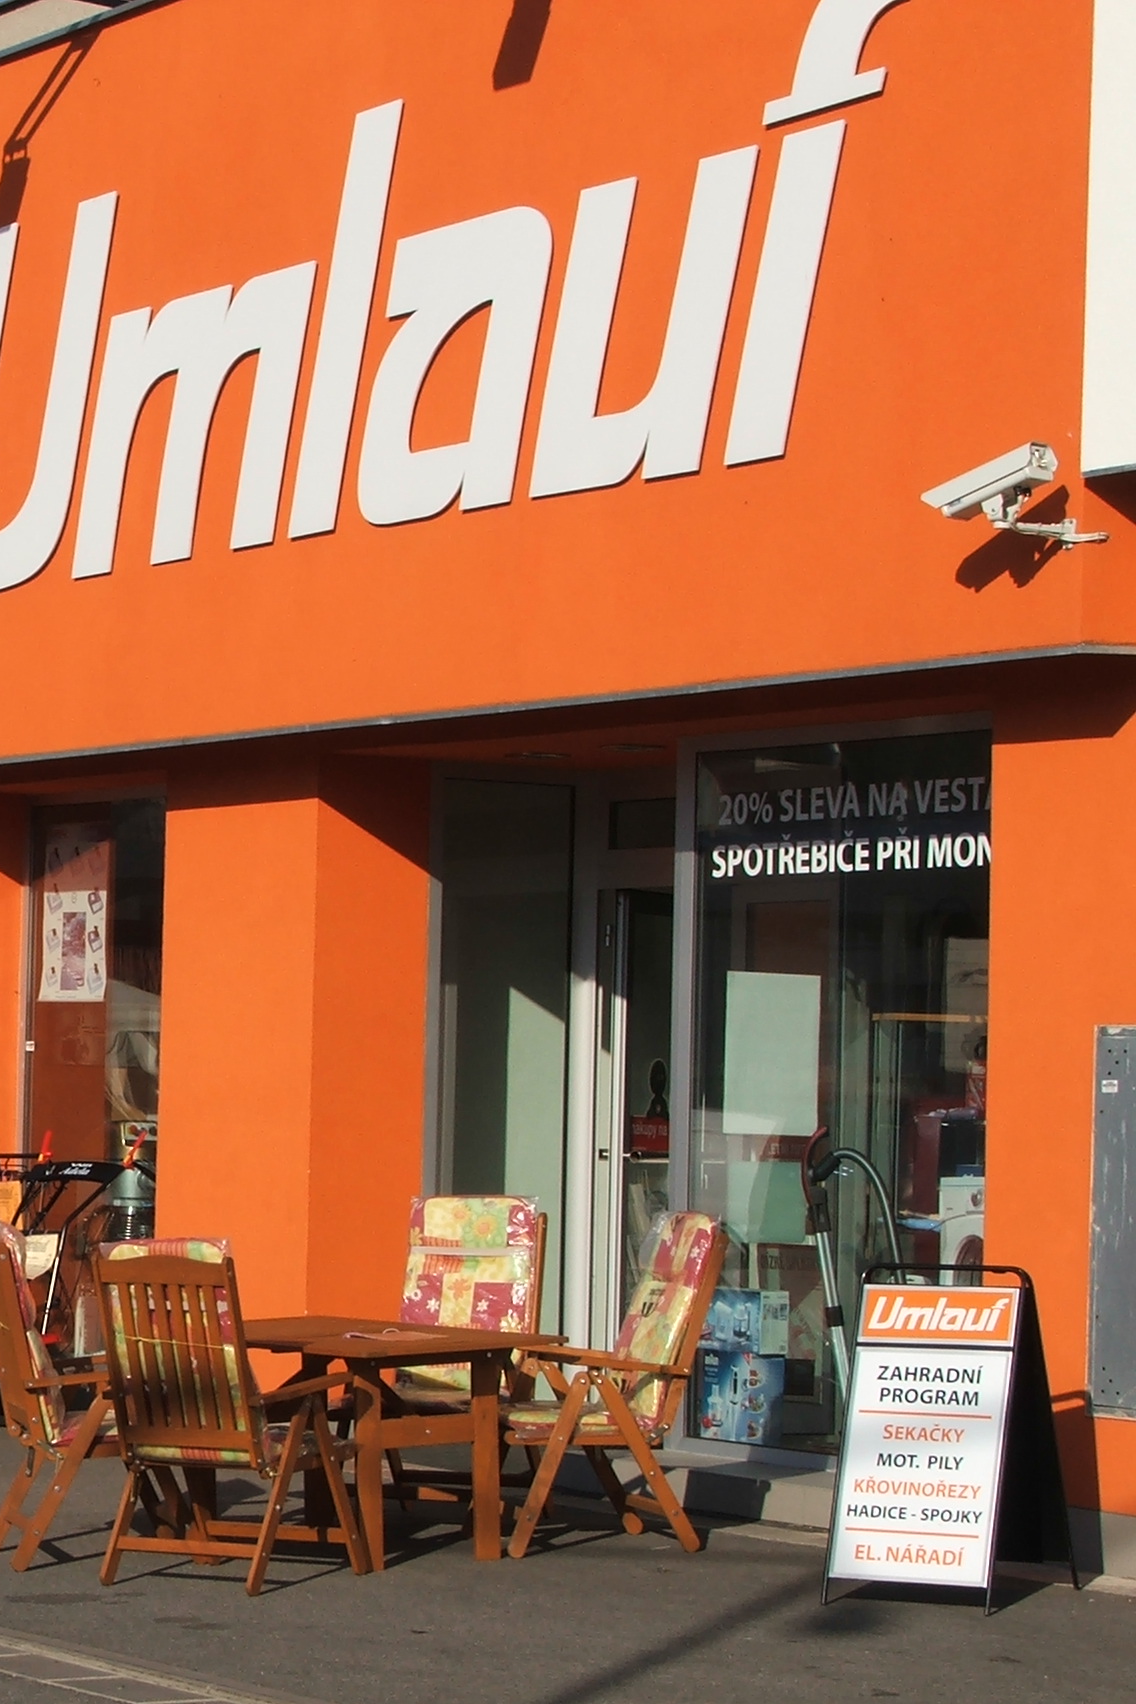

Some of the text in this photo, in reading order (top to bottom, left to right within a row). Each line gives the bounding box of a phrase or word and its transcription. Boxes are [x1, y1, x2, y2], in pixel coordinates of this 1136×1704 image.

[719, 792, 773, 826] 20%
[779, 782, 861, 822] SLEVA
[868, 782, 907, 816] NA
[712, 830, 870, 878] SPOTŘEBIČE
[876, 827, 920, 870] PŘI
[868, 1296, 1010, 1331] Umlauf
[877, 1364, 983, 1384] ZAHRADNÍ
[879, 1387, 979, 1406] PROGRAM
[883, 1423, 965, 1443] SEKAČKY
[877, 1453, 963, 1471] MOT. PILY
[854, 1476, 982, 1500] KŘOVINOŘEZY
[846, 1504, 907, 1520] HADICE
[920, 1508, 983, 1525] SPOJKY
[854, 1543, 965, 1567] EL. NÁŘADÍ
